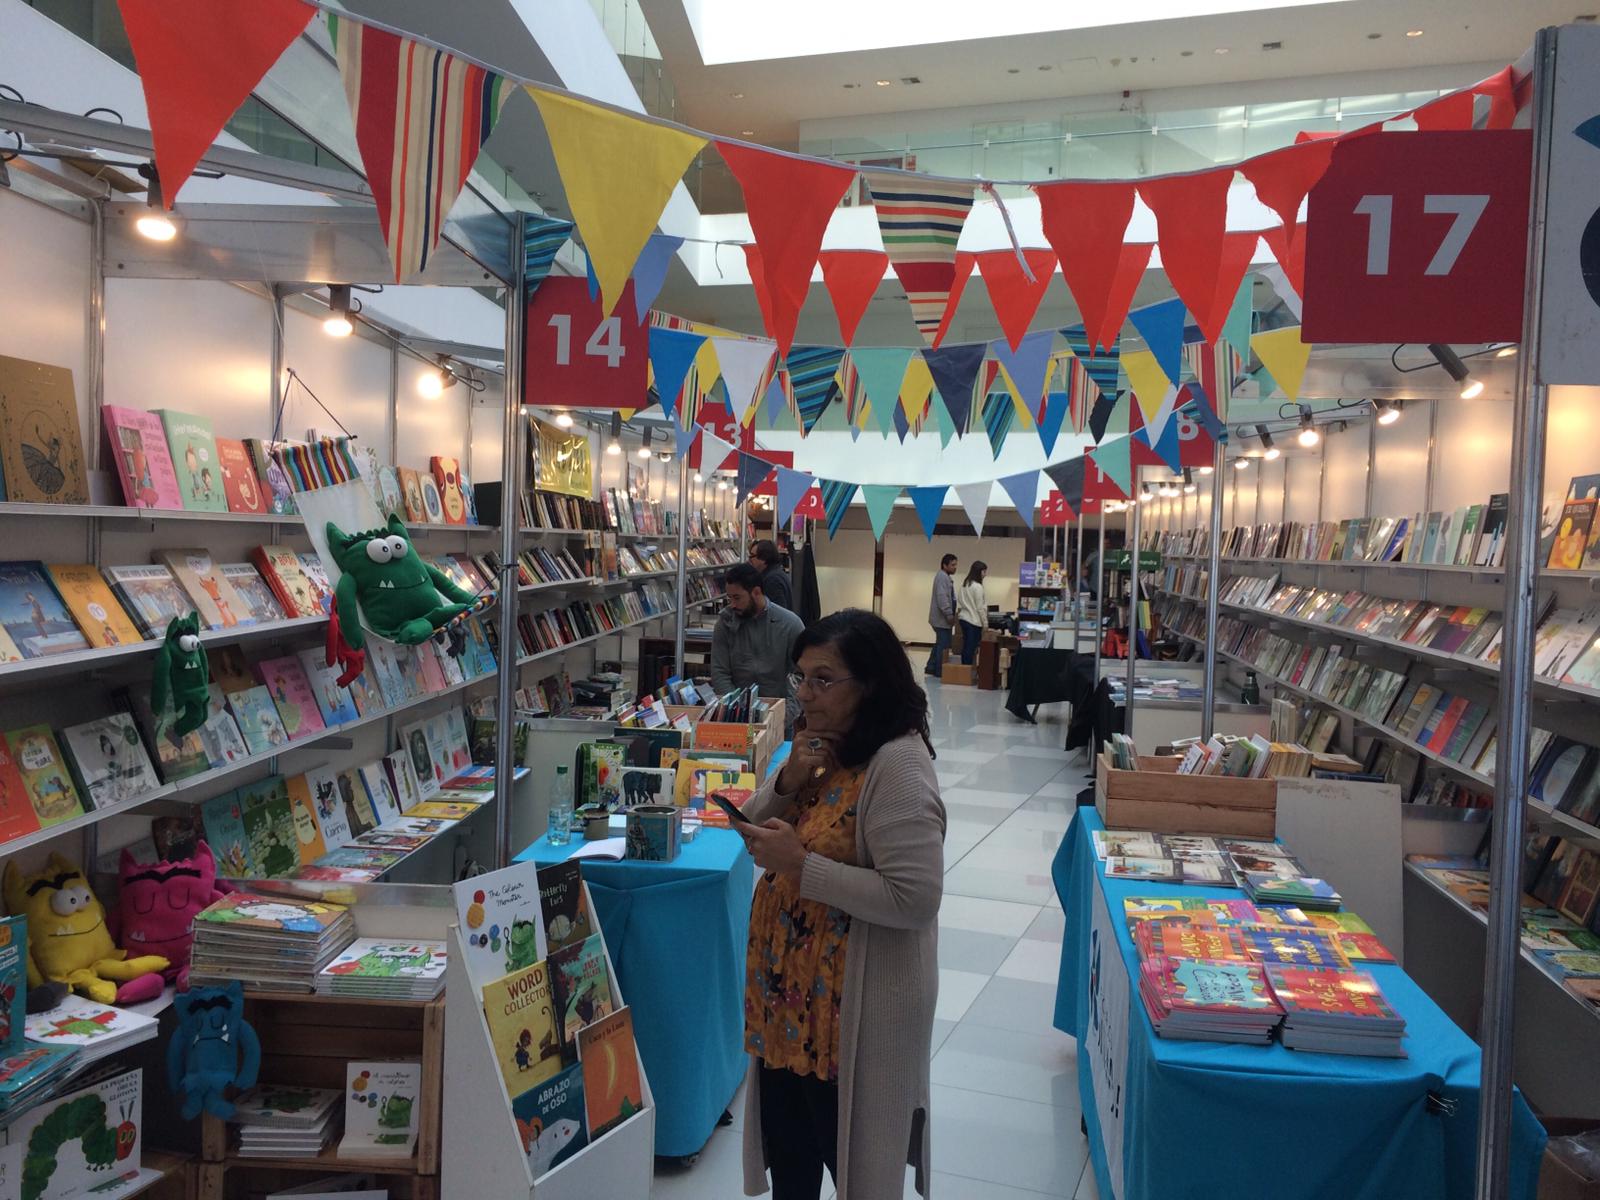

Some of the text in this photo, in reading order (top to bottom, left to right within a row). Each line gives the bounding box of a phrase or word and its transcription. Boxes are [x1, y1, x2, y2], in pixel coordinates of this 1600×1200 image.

[1353, 194, 1490, 276] 17
[547, 313, 625, 368] 14
[488, 888, 501, 898] The
[507, 968, 543, 1000] WORD
[504, 984, 552, 1016] COLLECTOR
[109, 1087, 138, 1102] GLOTONA
[537, 1078, 570, 1105] ABRAZO
[542, 1092, 567, 1115] DE OSO
